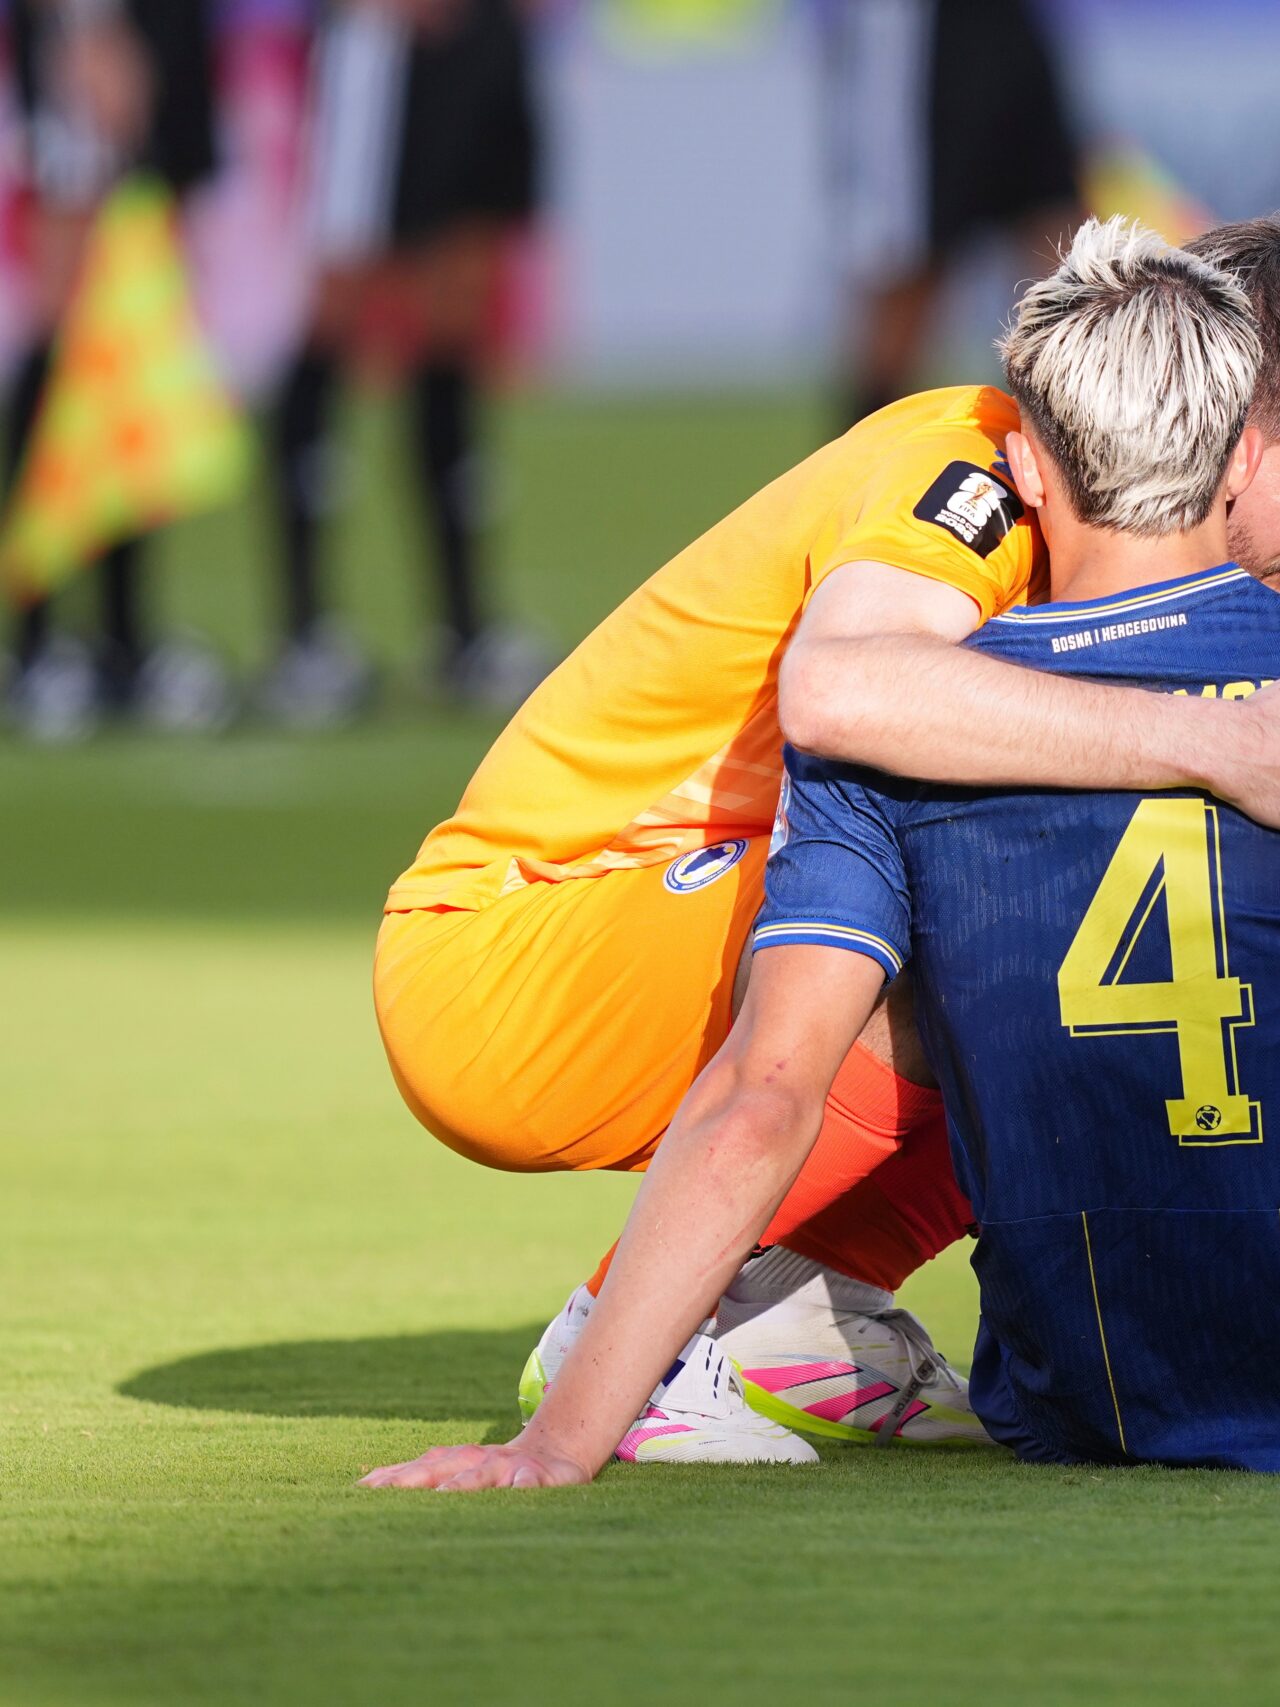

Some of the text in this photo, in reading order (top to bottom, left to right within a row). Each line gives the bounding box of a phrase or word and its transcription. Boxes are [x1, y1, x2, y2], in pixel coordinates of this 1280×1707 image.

[940, 508, 979, 535] WORLD CUP
[958, 503, 977, 519] FIFA
[934, 513, 974, 543] 2026
[1051, 613, 1187, 653] BOSNA I HERCEGOVINA
[1057, 798, 1263, 1146] 4
